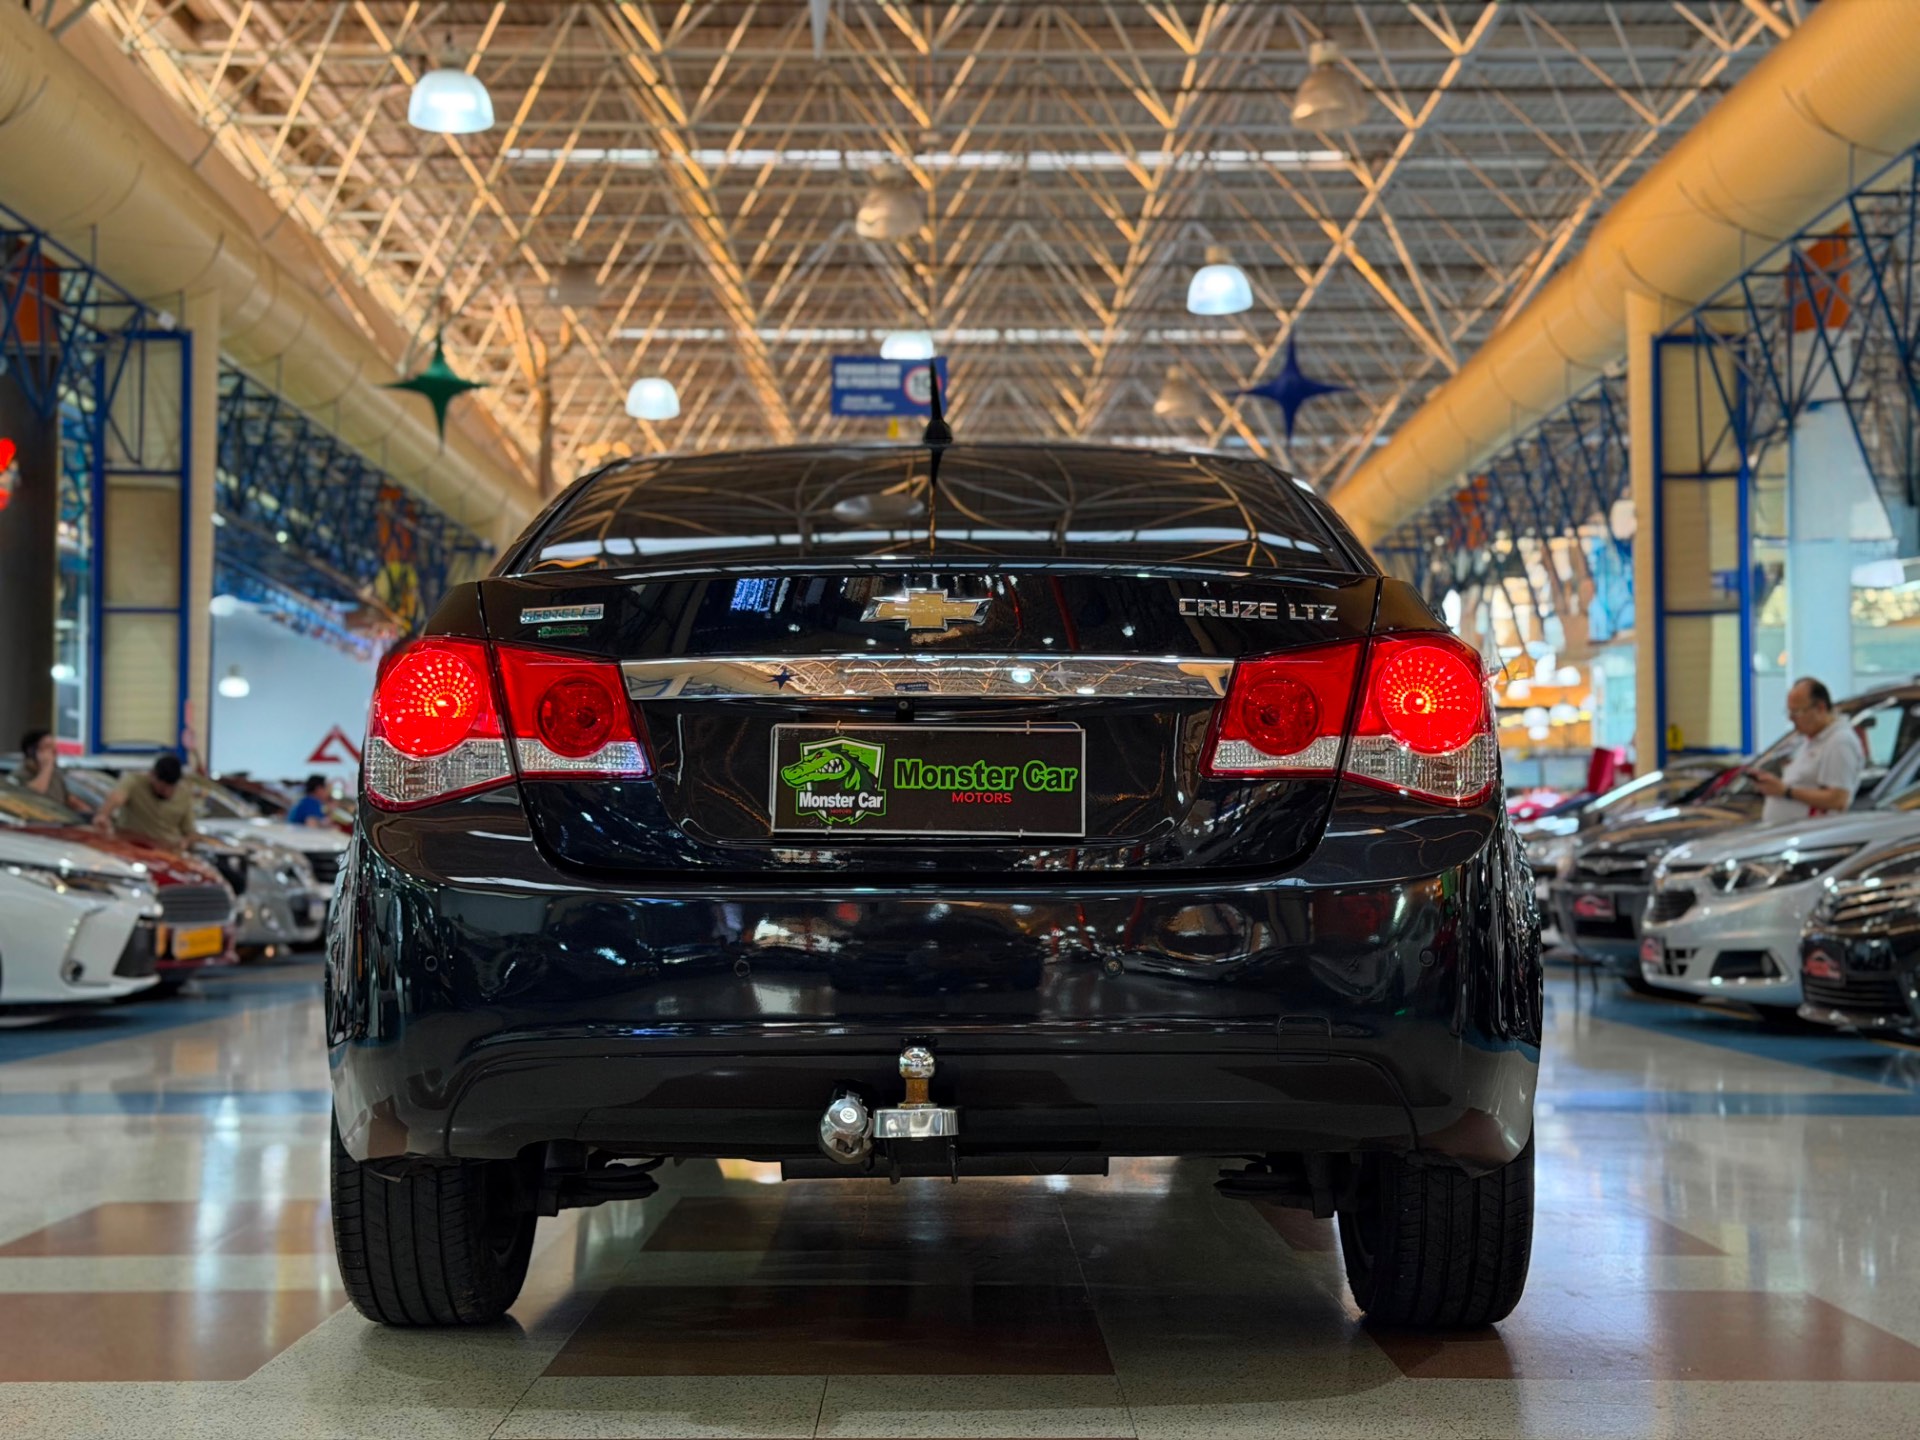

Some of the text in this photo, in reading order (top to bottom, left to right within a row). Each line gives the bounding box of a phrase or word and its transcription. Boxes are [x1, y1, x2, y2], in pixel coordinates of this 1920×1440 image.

[1179, 598, 1339, 621] CRUZE LTZ
[894, 759, 1078, 792] Monster Car
[799, 791, 883, 808] Monster Car
[951, 791, 1013, 804] MOTORS
